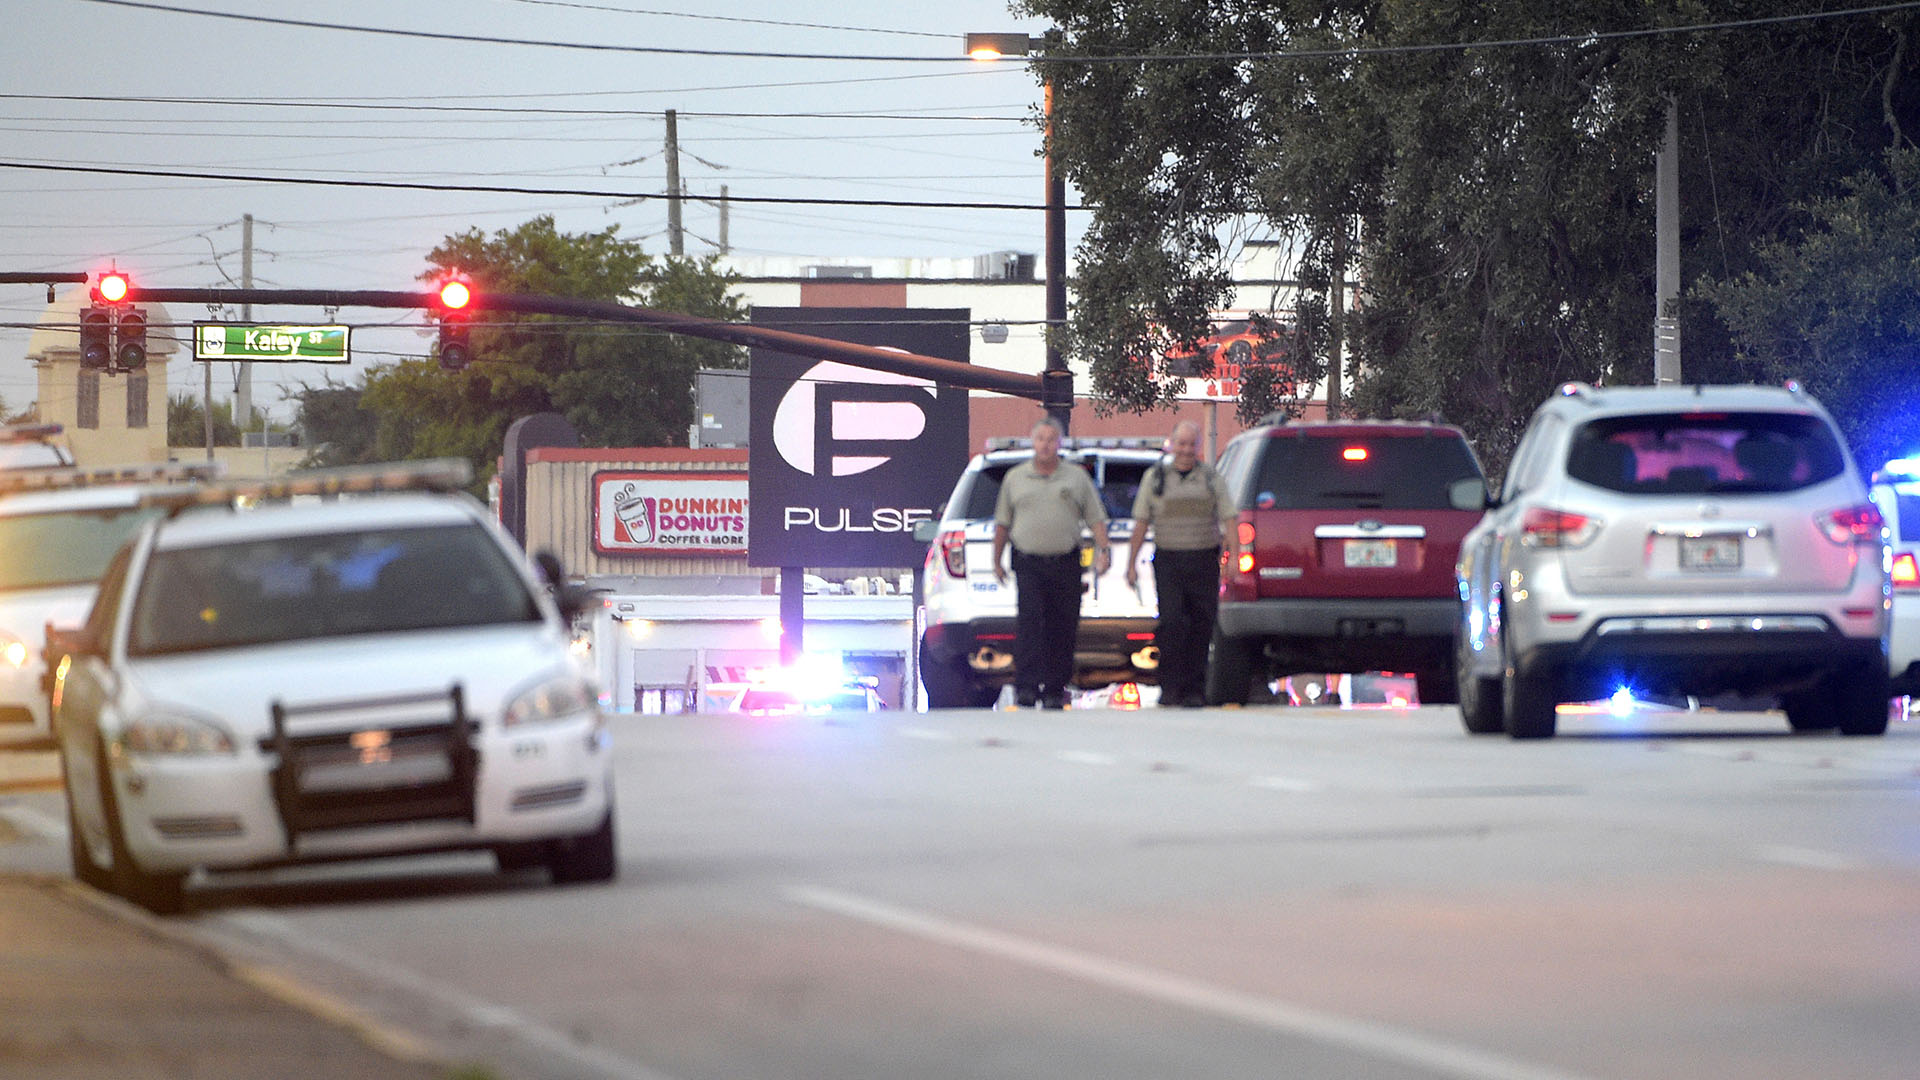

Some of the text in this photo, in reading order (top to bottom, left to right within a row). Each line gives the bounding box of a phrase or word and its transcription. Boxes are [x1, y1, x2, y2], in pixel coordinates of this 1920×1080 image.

[244, 330, 302, 355] Kaley
[658, 497, 749, 514] DUNKIN'
[659, 515, 745, 532] DONUTS
[784, 507, 933, 532] PULSE
[658, 534, 701, 545] COFFEE
[711, 535, 744, 545] MORE
